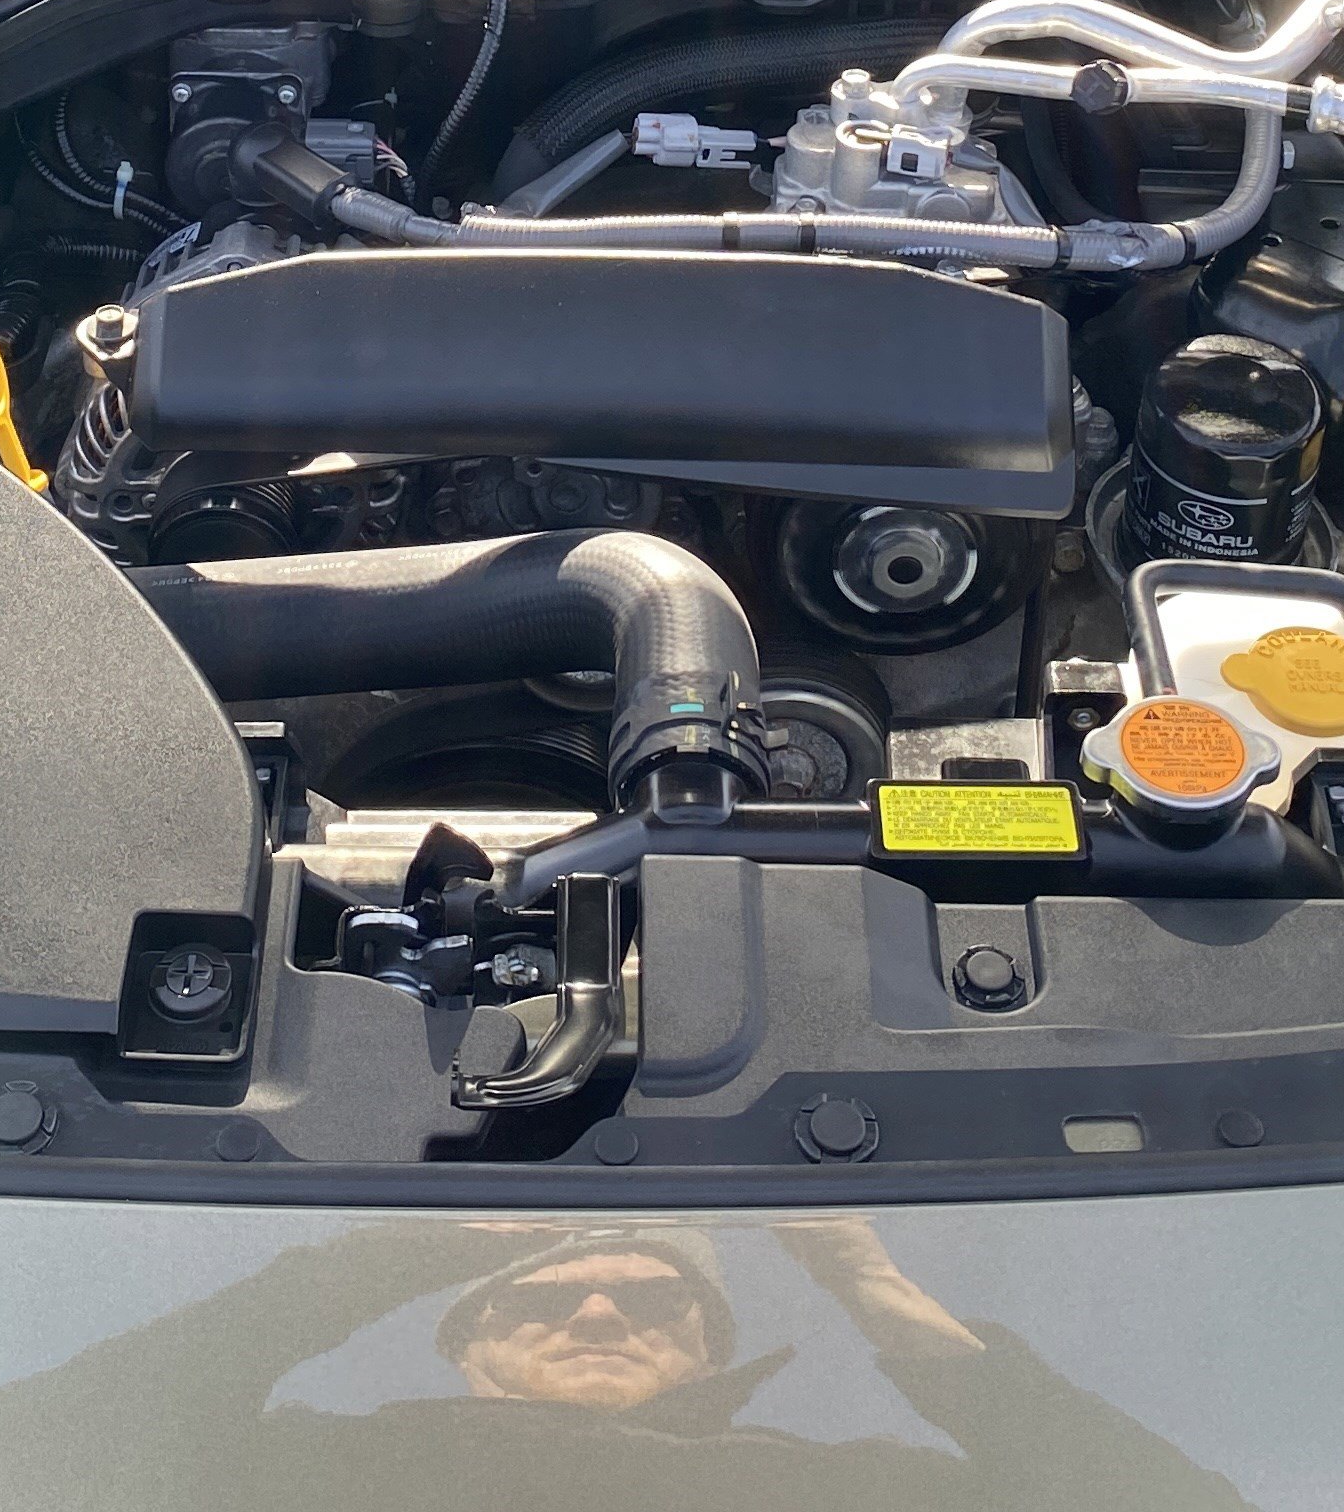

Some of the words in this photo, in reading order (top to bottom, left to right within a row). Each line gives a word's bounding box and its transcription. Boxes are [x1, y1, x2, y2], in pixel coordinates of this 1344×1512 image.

[1158, 511, 1254, 548] SUBARU
[1150, 517, 1177, 543] MADE
[1178, 537, 1192, 548] IN
[1194, 543, 1259, 557] INDONESIA
[1161, 711, 1210, 719] WARNING
[1150, 768, 1226, 779] AVERTISSEMENT
[920, 790, 950, 798] CAUTION
[954, 790, 992, 798] ATTENTION
